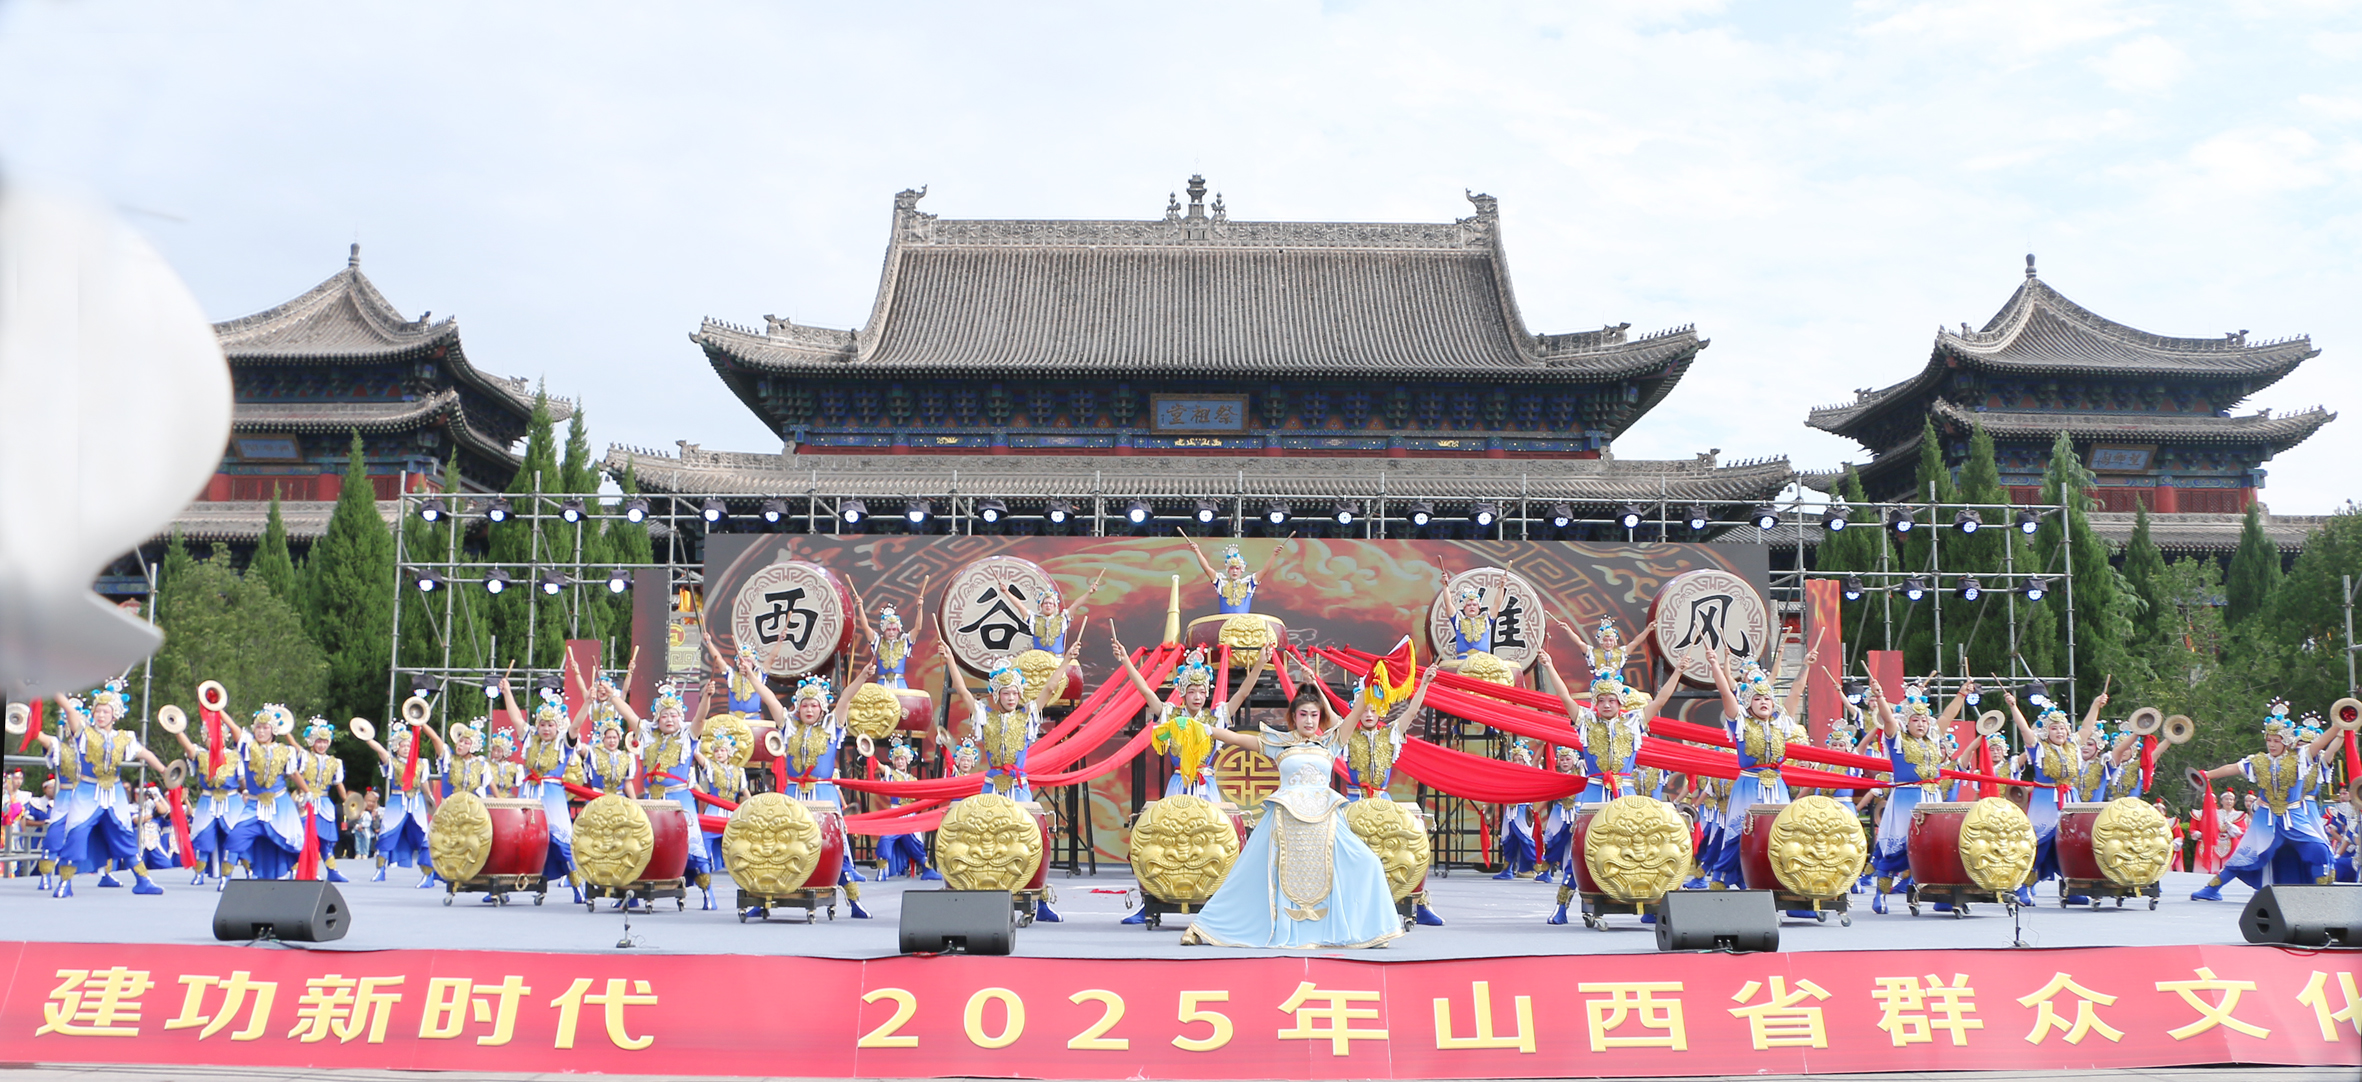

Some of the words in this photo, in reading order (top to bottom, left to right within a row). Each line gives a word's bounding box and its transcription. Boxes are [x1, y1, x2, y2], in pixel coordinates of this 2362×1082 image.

[1166, 403, 1237, 425] 祭祖堂
[756, 588, 818, 650] 西
[958, 584, 1033, 650] 谷
[1676, 594, 1750, 658] 风
[35, 966, 659, 1050] 建功新时代
